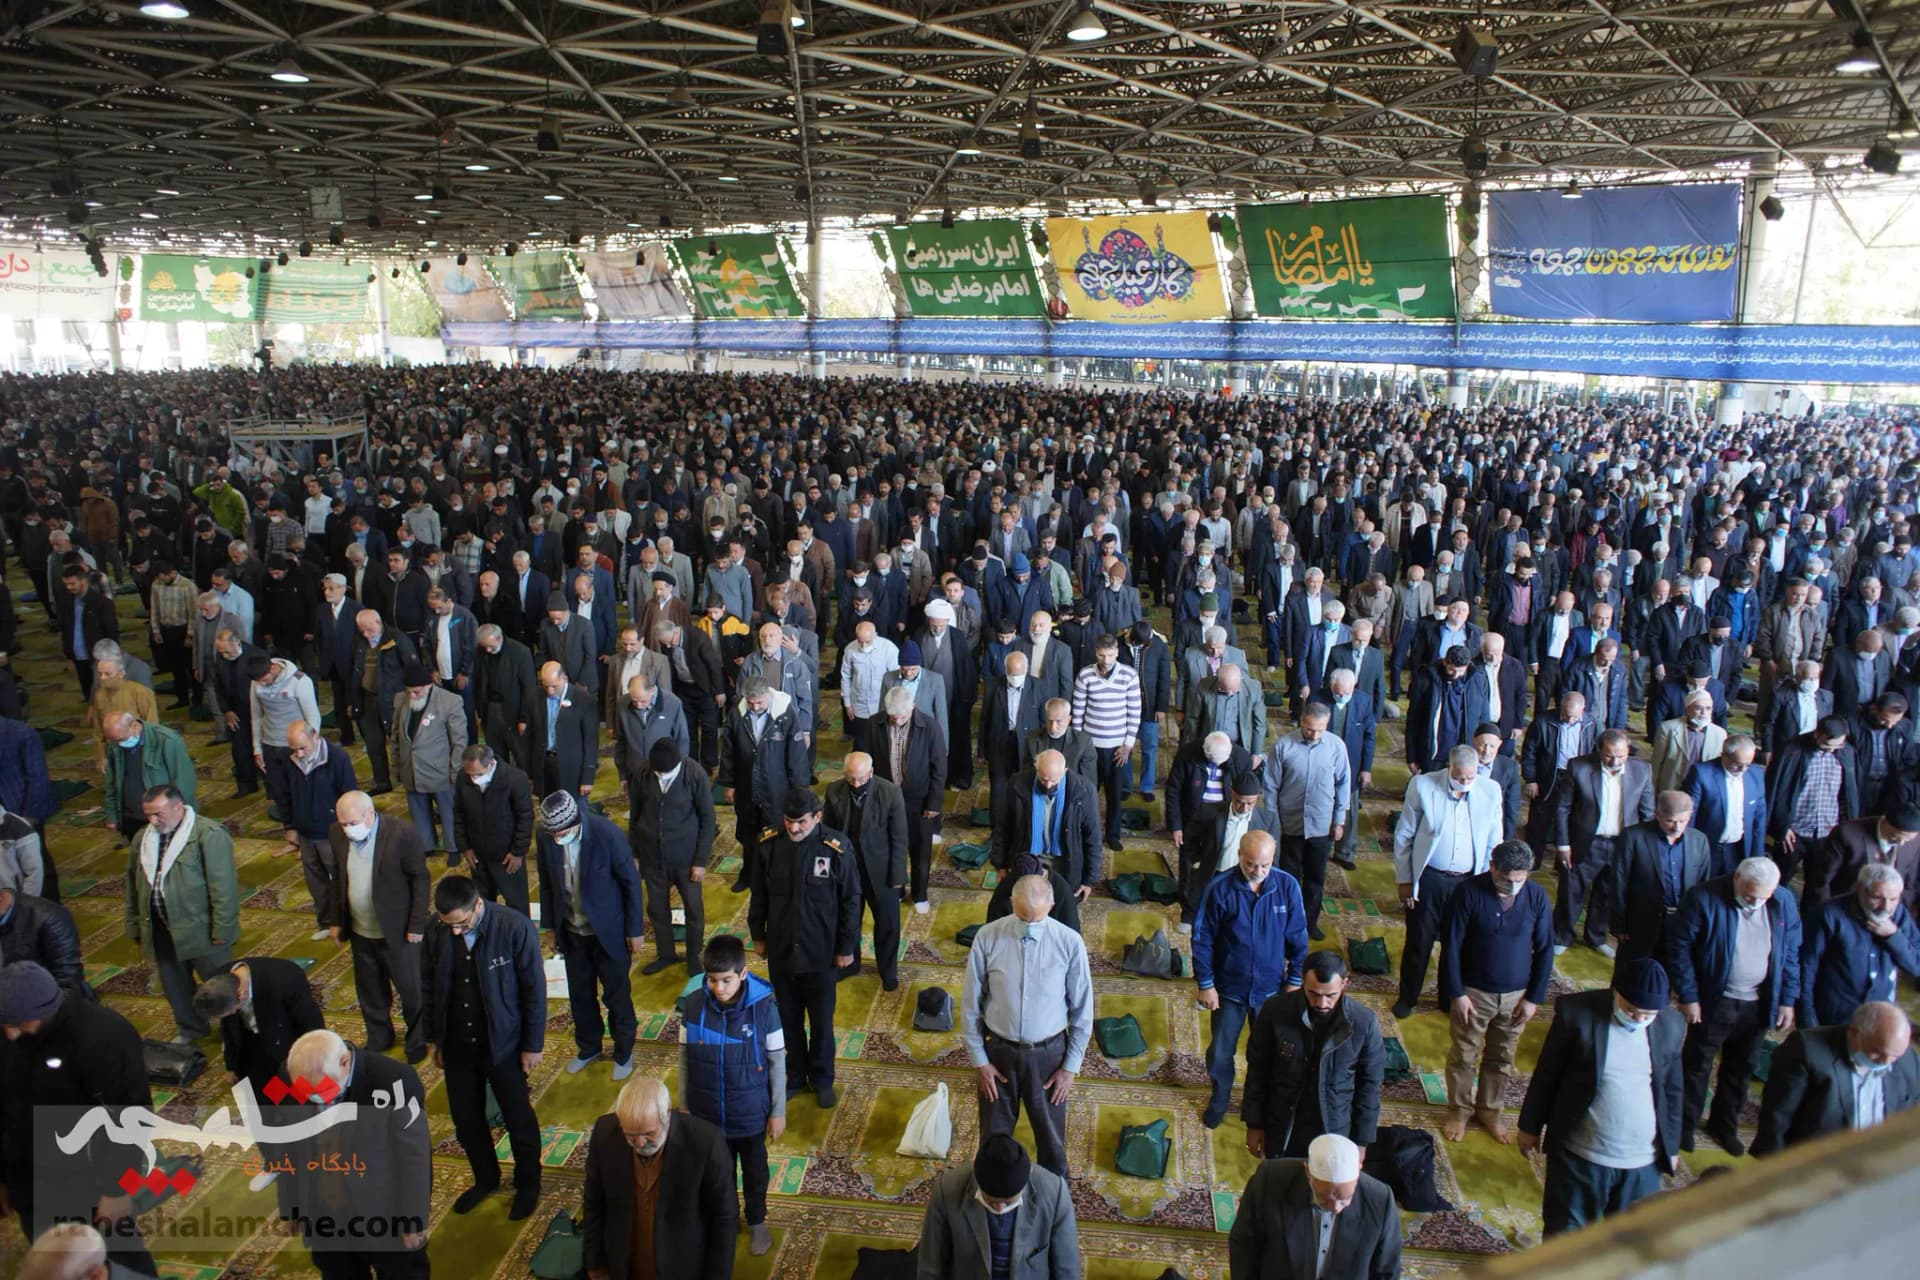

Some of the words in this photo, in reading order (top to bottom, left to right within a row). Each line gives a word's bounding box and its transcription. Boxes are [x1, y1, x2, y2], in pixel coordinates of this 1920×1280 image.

[972, 235, 1020, 267] ایران
[992, 273, 1031, 306] امام
[1145, 260, 1185, 294] نماز
